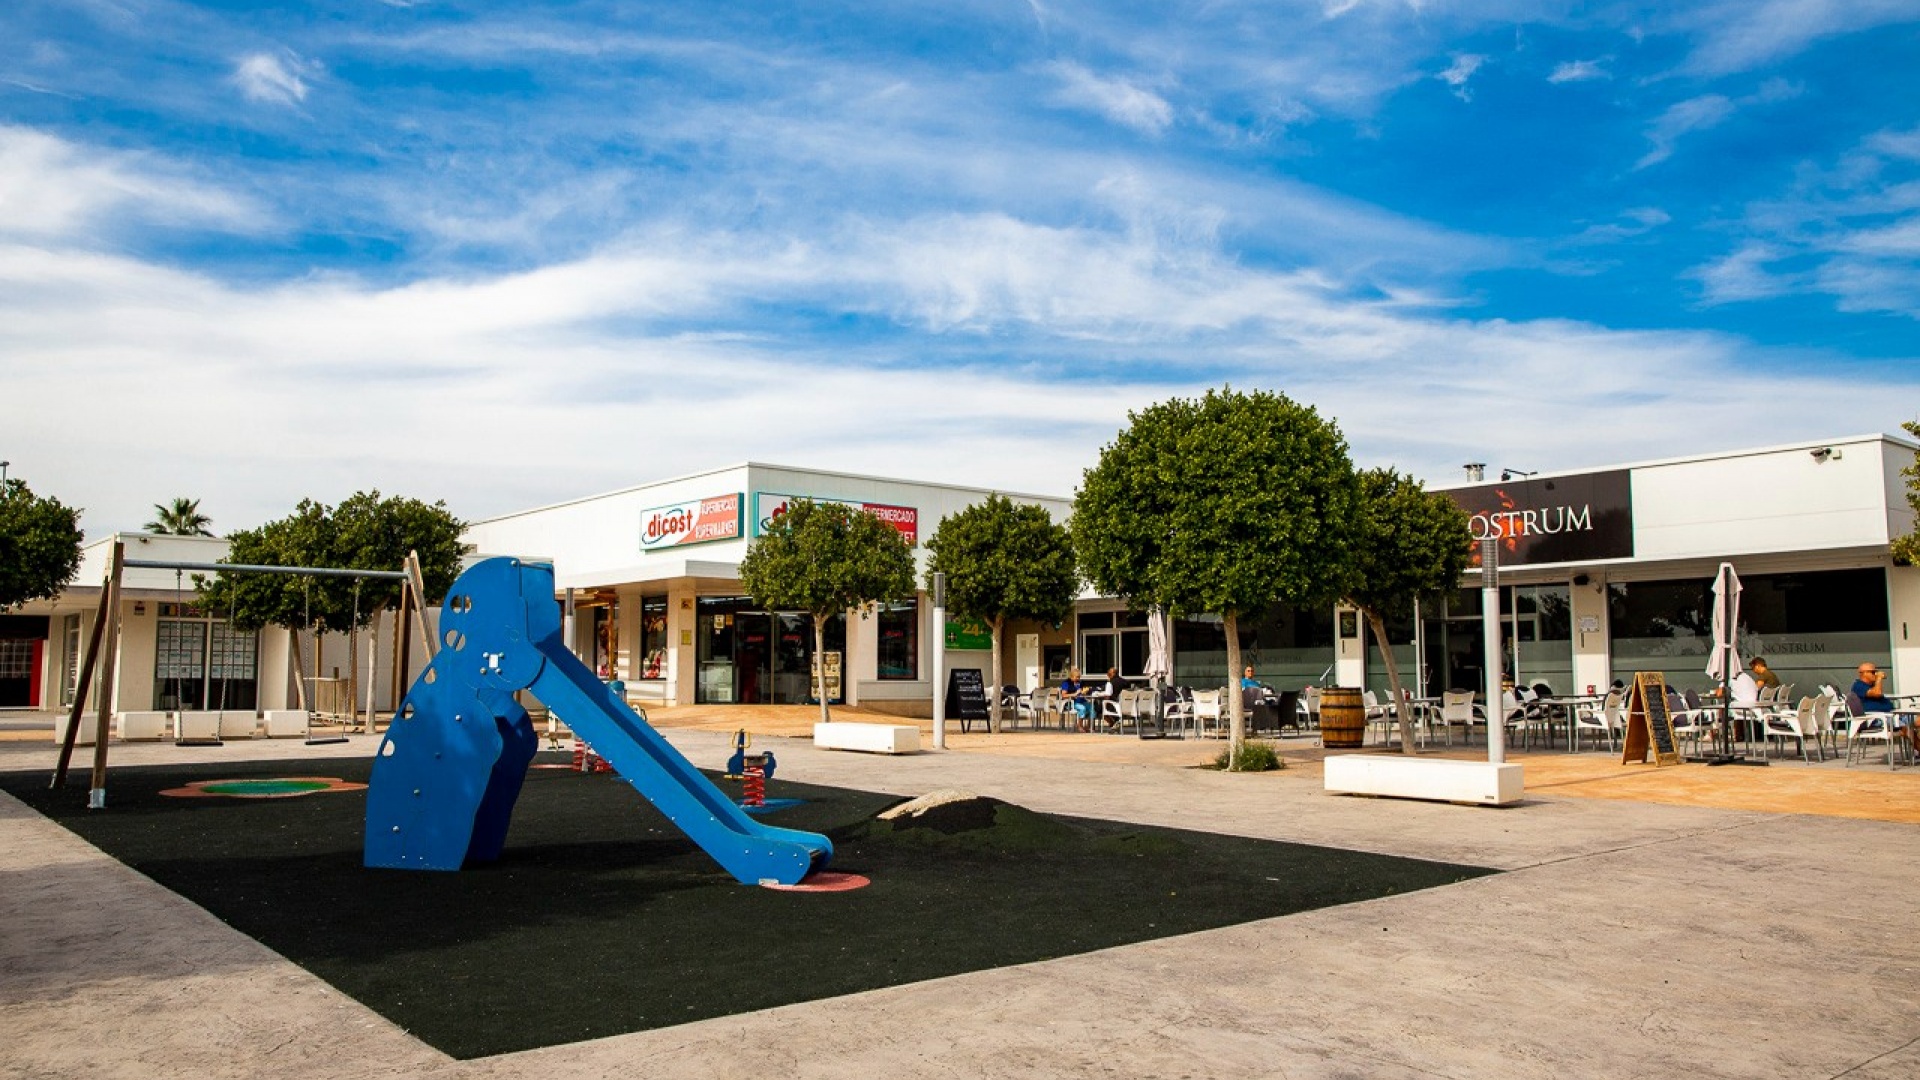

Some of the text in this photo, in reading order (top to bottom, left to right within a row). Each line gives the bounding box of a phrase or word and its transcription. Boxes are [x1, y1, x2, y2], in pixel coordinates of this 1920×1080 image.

[647, 509, 693, 537] dicost
[1468, 503, 1594, 540] OSTRUM
[1762, 642, 1825, 654] NOSTRUM
